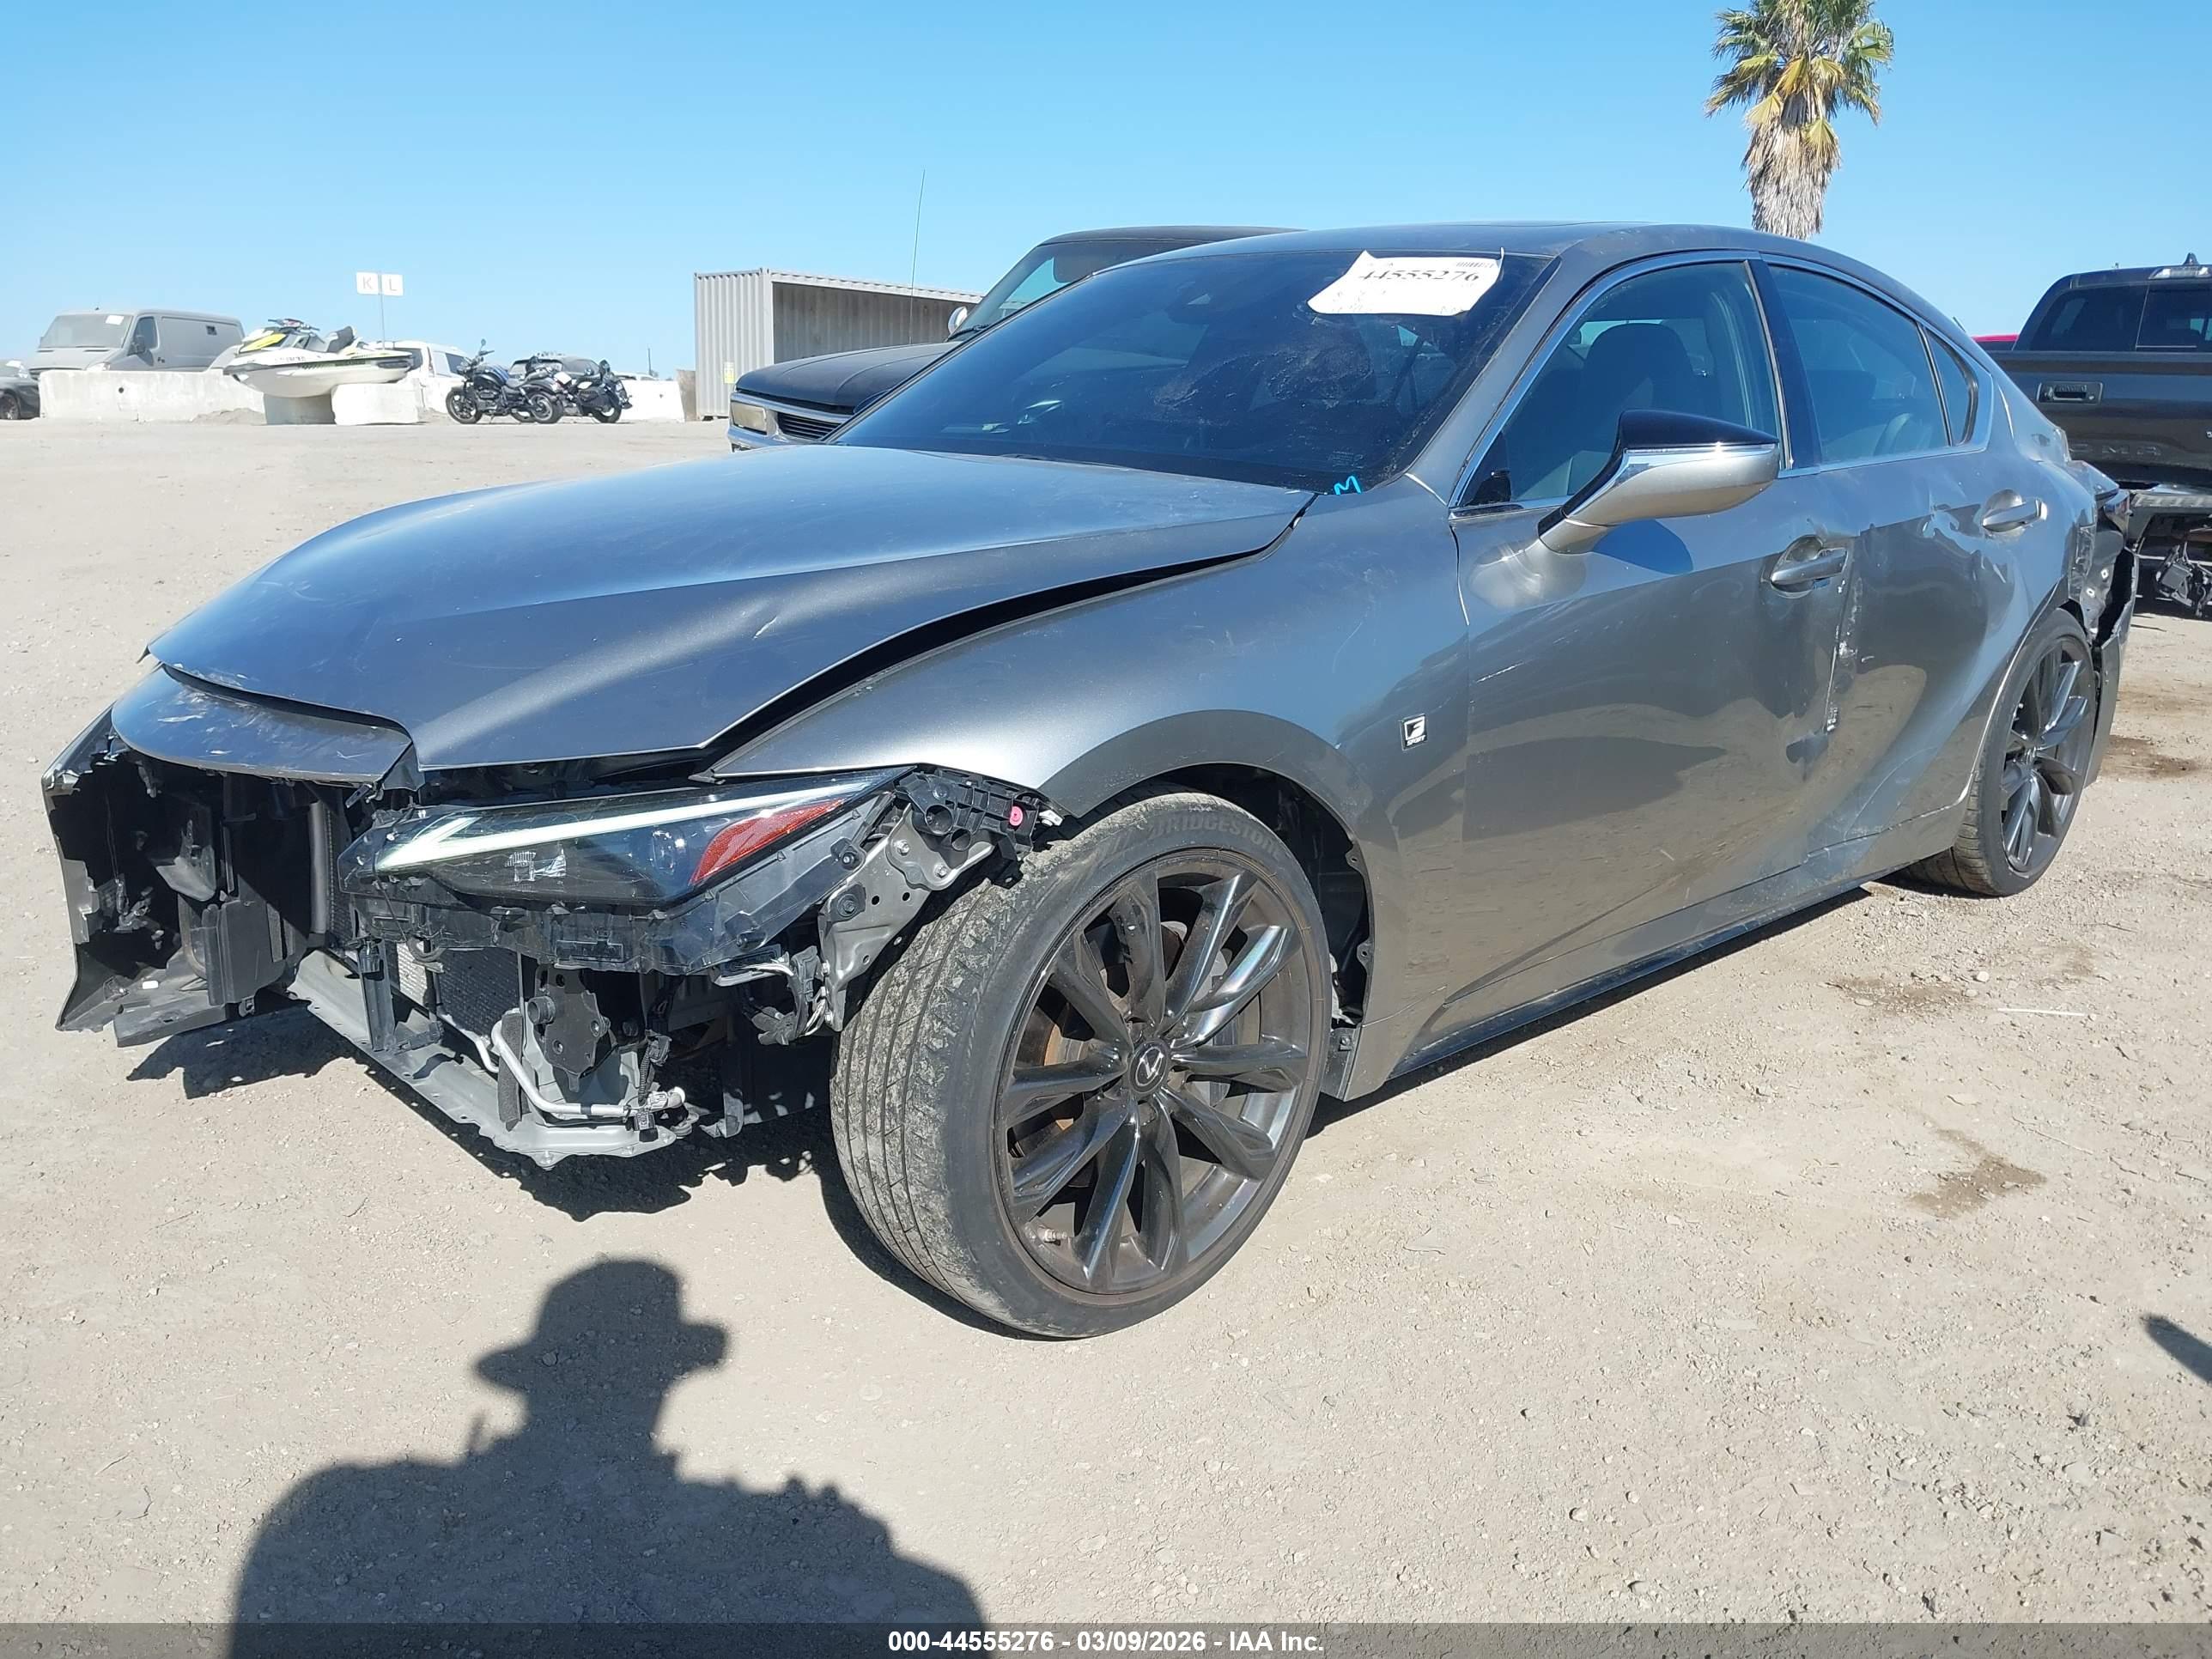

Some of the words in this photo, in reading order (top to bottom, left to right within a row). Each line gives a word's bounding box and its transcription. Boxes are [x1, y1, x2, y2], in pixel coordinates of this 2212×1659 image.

[362, 275, 374, 289] K
[1358, 269, 1480, 282] 44555276
[389, 278, 398, 292] L
[1334, 475, 1362, 495] M
